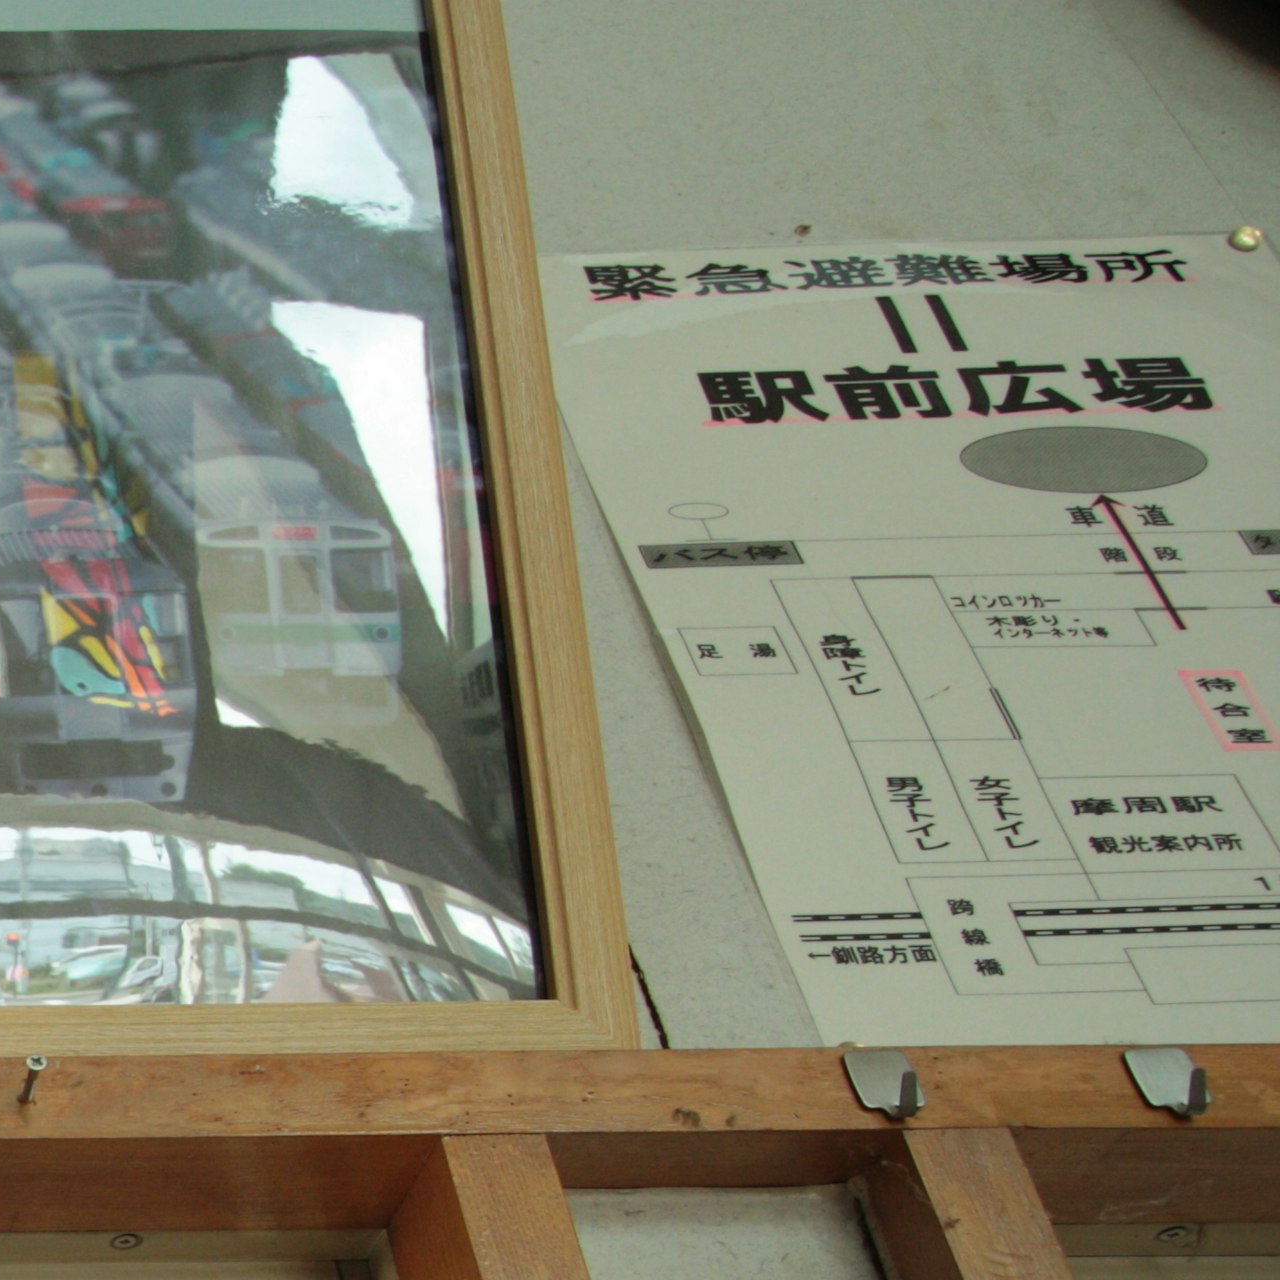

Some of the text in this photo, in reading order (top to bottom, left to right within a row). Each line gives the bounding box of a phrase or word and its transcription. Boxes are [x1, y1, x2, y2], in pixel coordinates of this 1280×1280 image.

[582, 249, 1188, 299] 緊急避難場所
[697, 356, 1214, 423] 駅前広場
[1064, 503, 1175, 528] 車道
[653, 544, 789, 563] バス停
[1099, 546, 1183, 563] 階段
[950, 593, 1062, 609] コインロッカー
[993, 626, 1110, 639] インターネット等
[697, 643, 777, 659] 足湯
[820, 634, 881, 695] 身障トイレ
[1195, 677, 1272, 744] 待合室
[886, 777, 950, 850] 男子トイレ
[969, 776, 1039, 849] 女子トイレ
[1070, 795, 1224, 816] 摩周駅
[1088, 833, 1244, 854] 観光案内所
[947, 898, 1005, 977] 跨線橋
